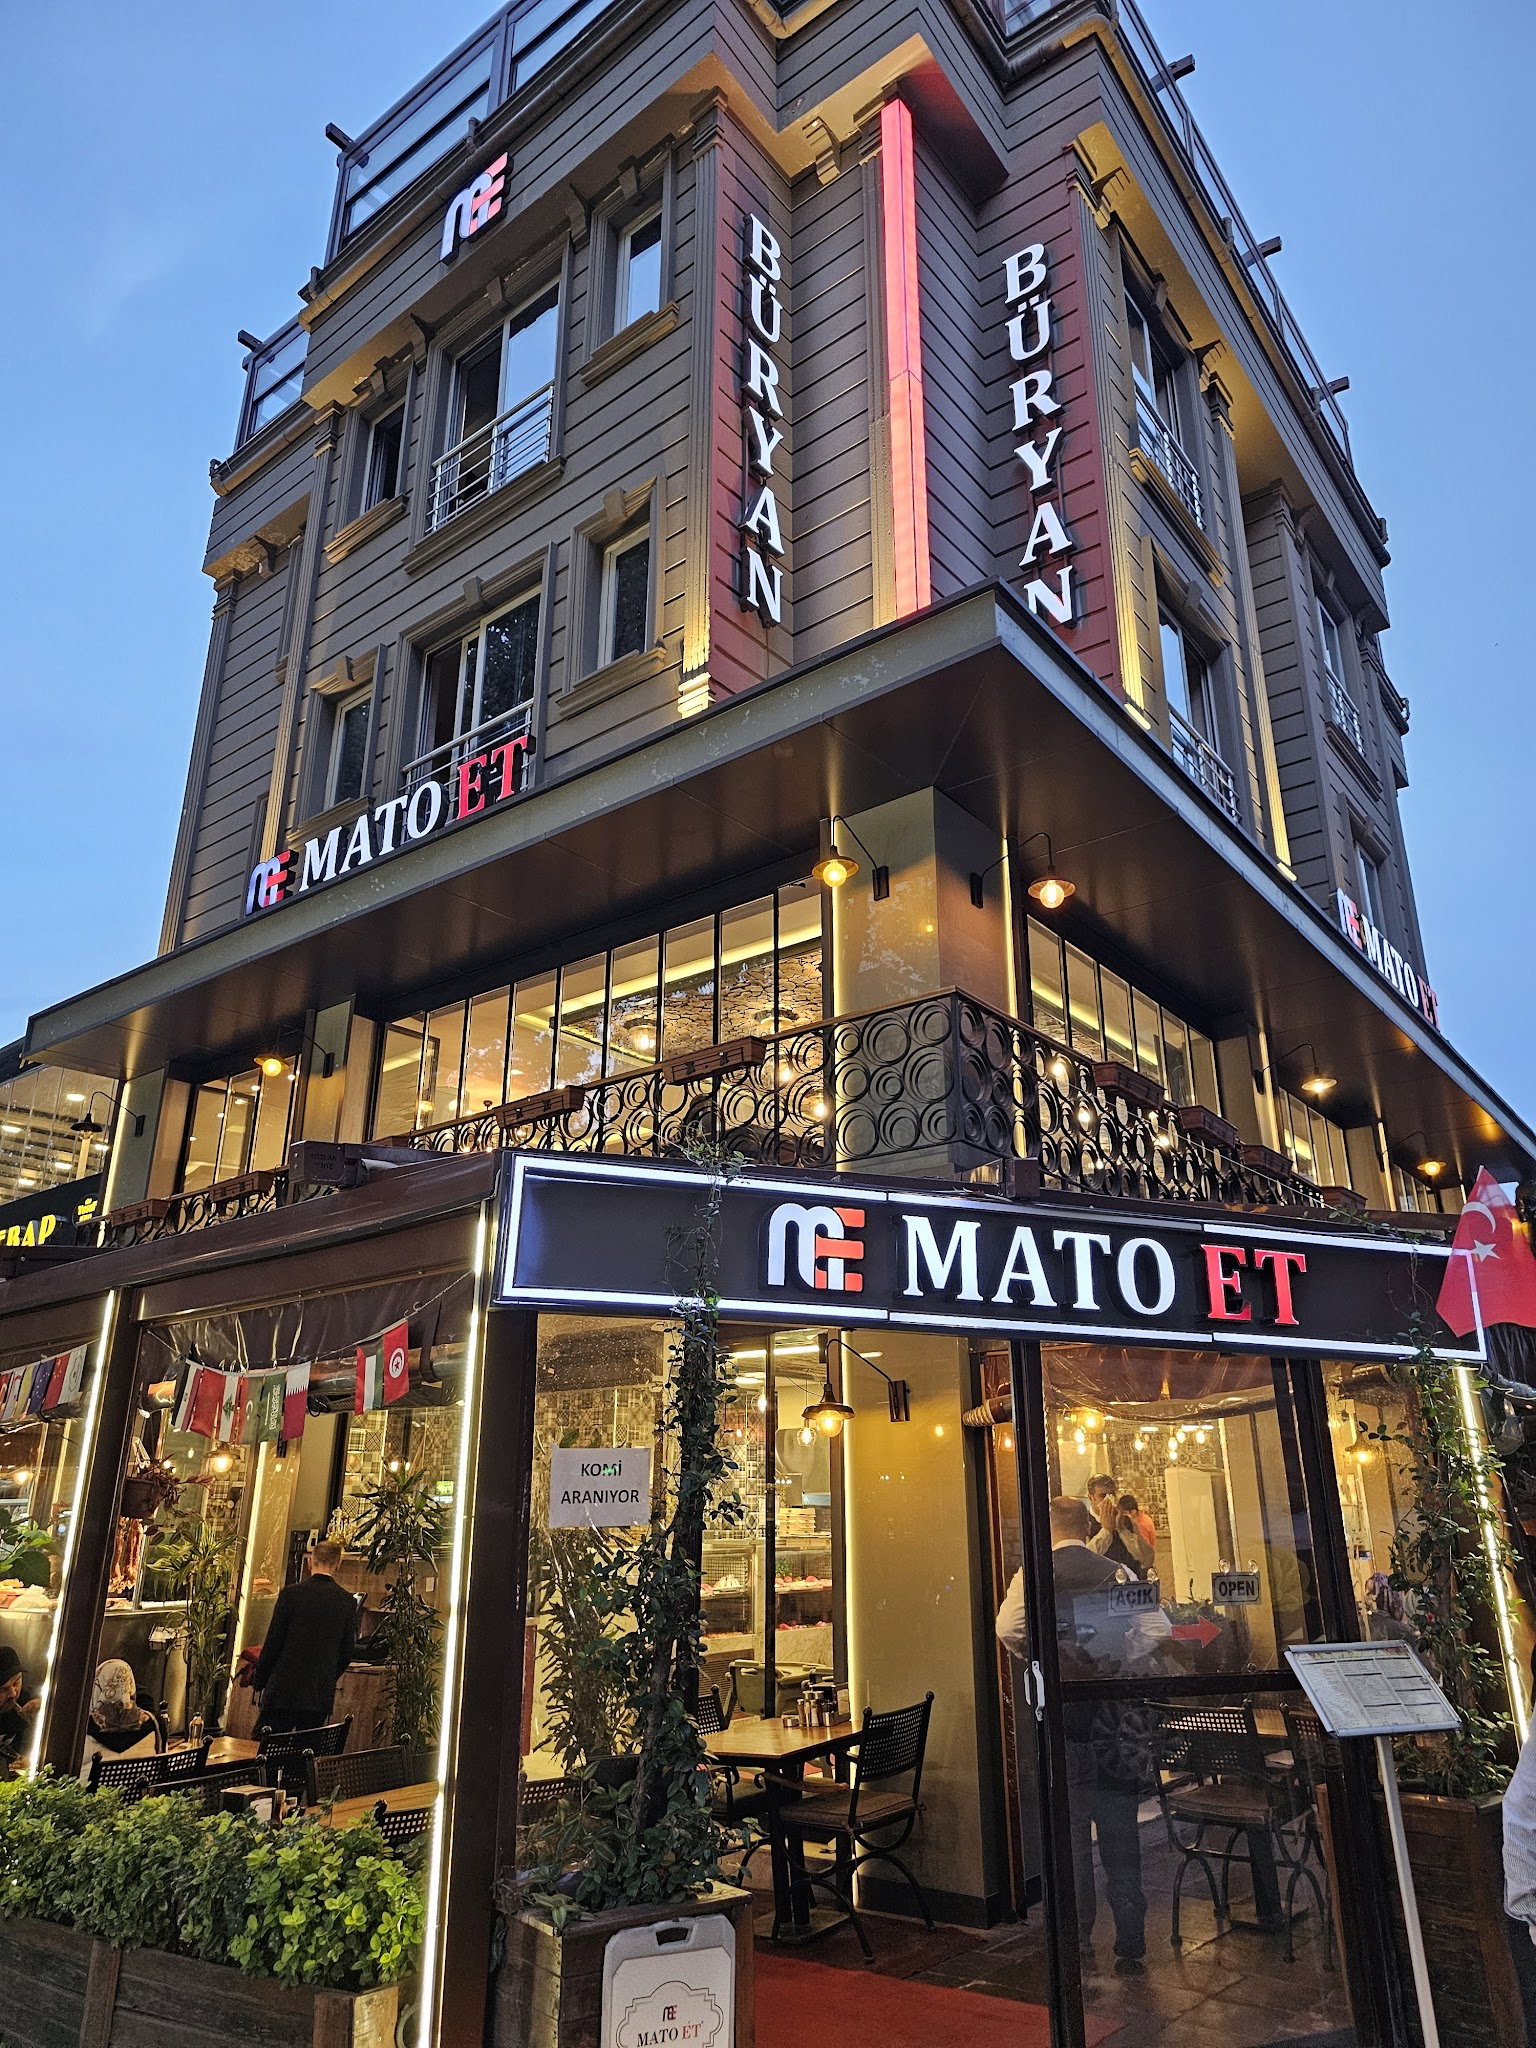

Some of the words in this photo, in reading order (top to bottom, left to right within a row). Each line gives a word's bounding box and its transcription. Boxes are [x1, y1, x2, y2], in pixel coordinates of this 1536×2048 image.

[747, 213, 784, 626] BÜRYAN
[1002, 243, 1073, 625] BÜRYAN
[299, 781, 443, 892] MATO
[457, 735, 528, 820] ET
[1361, 913, 1419, 1008] MATO
[1417, 974, 1441, 1033] ET
[902, 1214, 1177, 1316] MATO
[1201, 1243, 1308, 1326] ET
[561, 1489, 640, 1505] ARANIYOR
[581, 1460, 622, 1477] KOMİ
[1115, 1588, 1155, 1610] AÇIK
[1218, 1580, 1255, 1597] OPEN
[636, 2026, 679, 2048] MATO
[681, 2021, 703, 2040] ET
